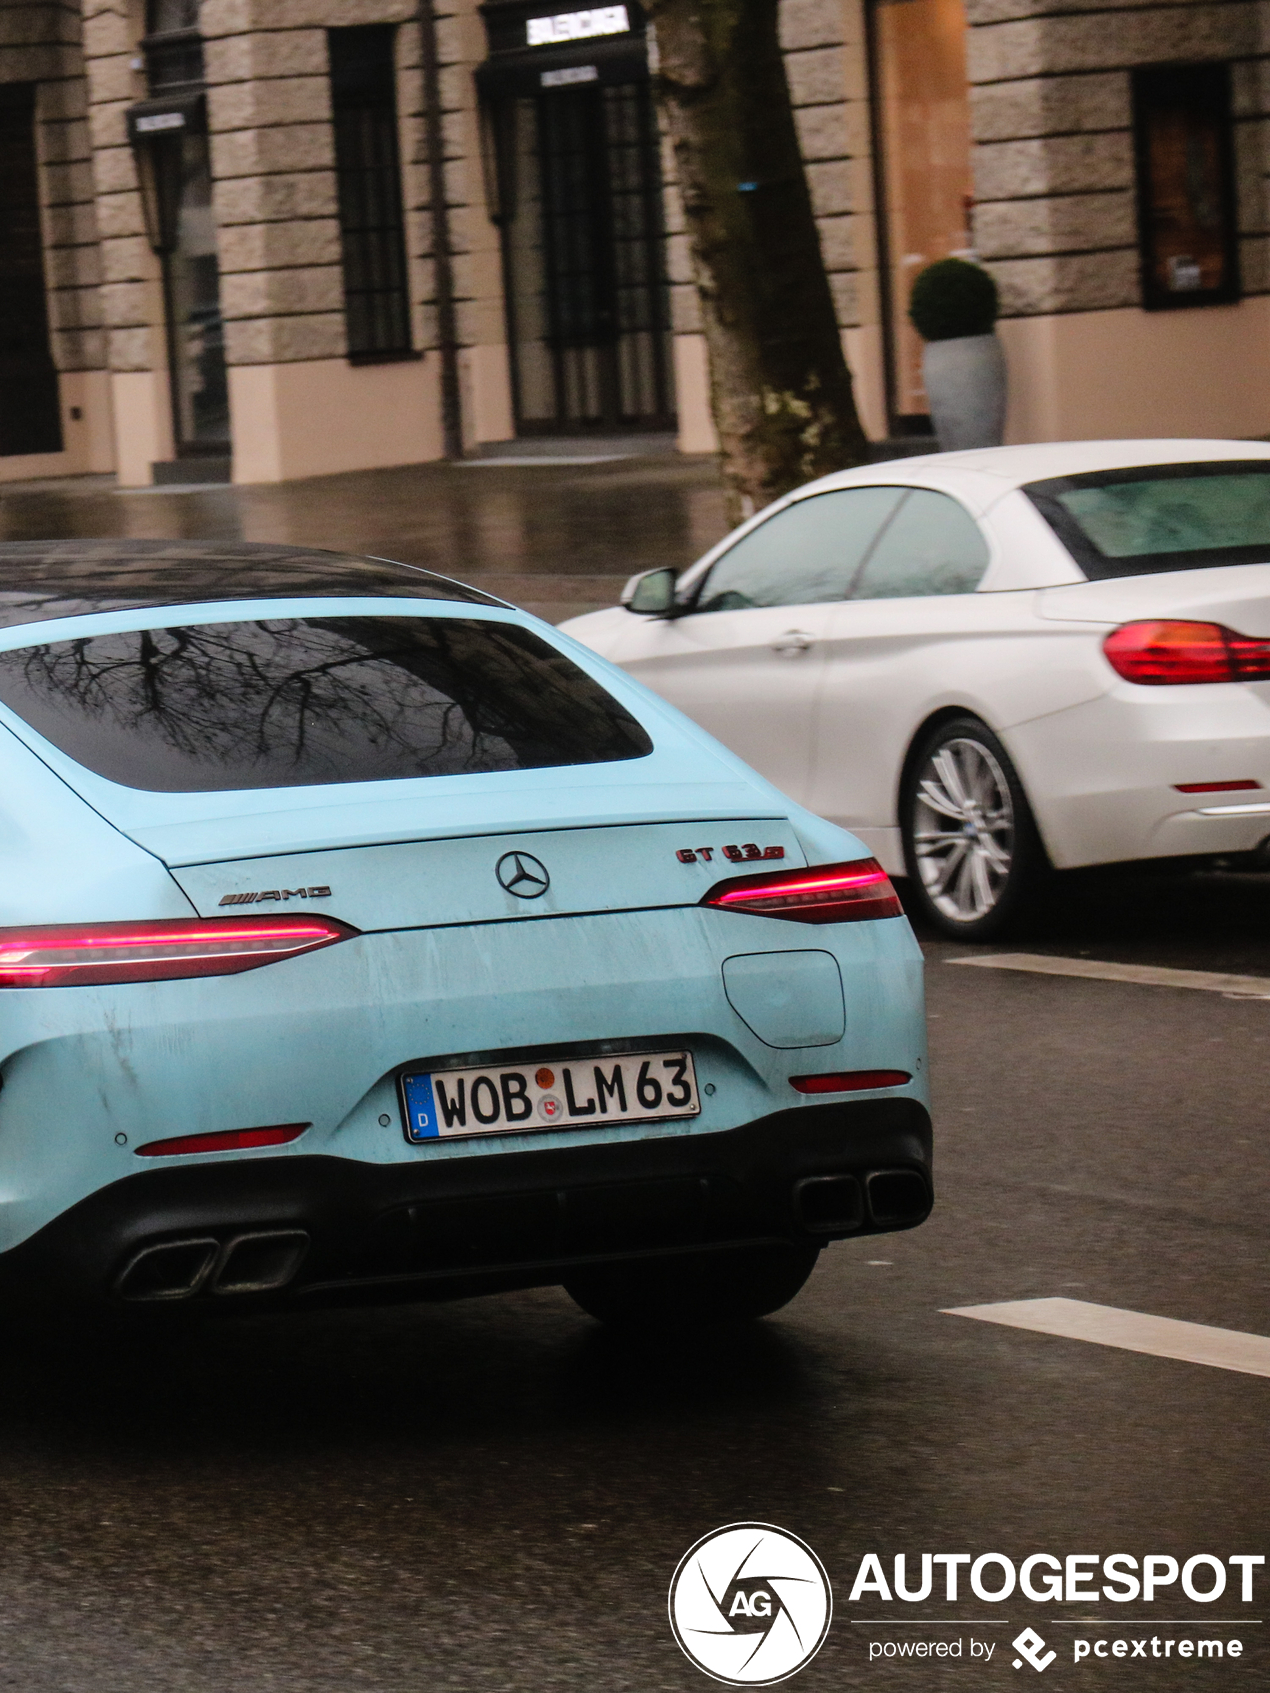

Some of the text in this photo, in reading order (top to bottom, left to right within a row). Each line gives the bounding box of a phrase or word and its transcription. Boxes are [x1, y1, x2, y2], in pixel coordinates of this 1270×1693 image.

[675, 846, 714, 864] GT
[253, 885, 332, 903] AMG
[435, 1072, 533, 1129] WOB
[418, 1112, 429, 1127] D
